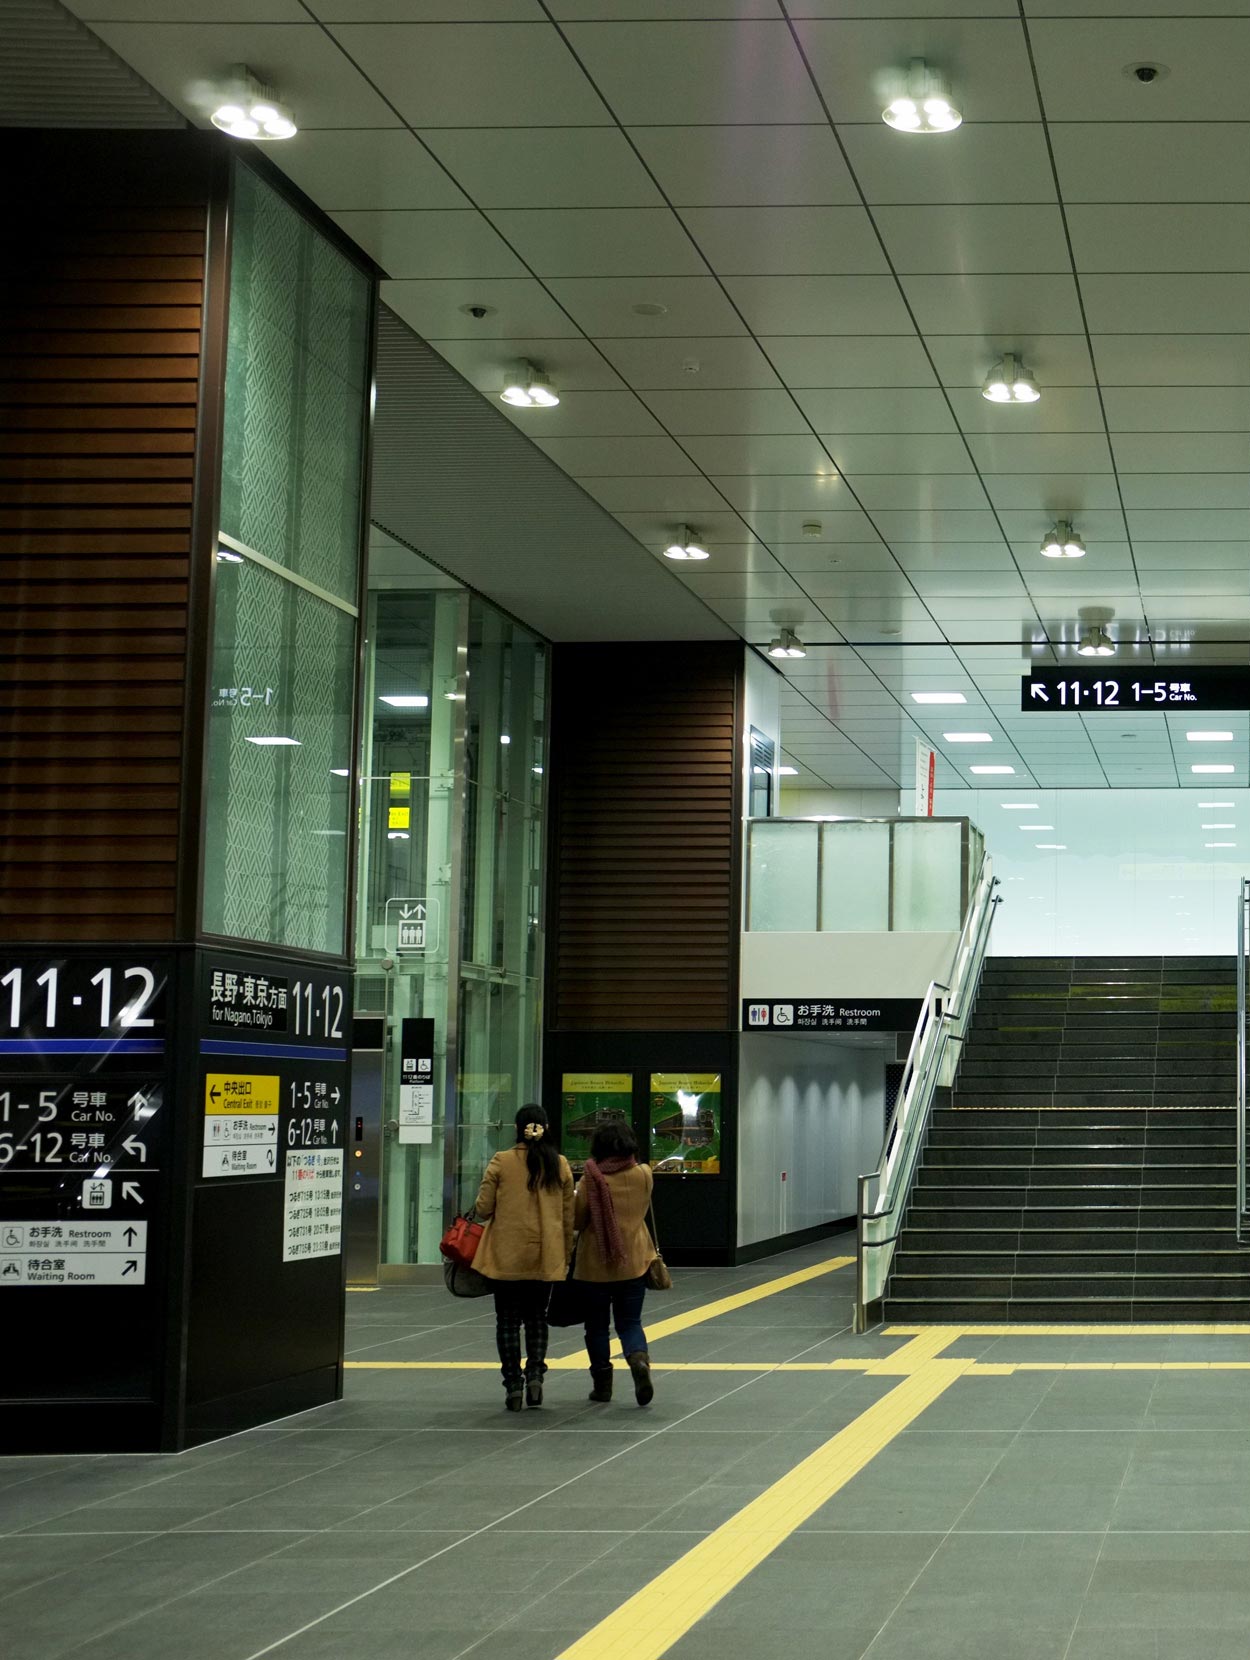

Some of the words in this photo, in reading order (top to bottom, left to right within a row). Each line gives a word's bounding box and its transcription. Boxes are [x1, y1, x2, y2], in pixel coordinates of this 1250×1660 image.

[1169, 693, 1182, 701] Car
[212, 1005, 222, 1021] for
[797, 1005, 835, 1017] お手洗
[839, 1008, 881, 1017] Restroom
[224, 1081, 252, 1096] 中央出口
[72, 1091, 108, 1108] 号車
[223, 1099, 242, 1109] Central
[71, 1110, 92, 1122] Car
[95, 1110, 116, 1122] No.
[70, 1133, 106, 1149] 号車
[69, 1151, 90, 1163] Car
[93, 1151, 114, 1163] No.
[29, 1226, 63, 1238] お手洗
[68, 1229, 112, 1238] Restroom
[28, 1259, 66, 1271] 待合室
[27, 1272, 65, 1282] Waiting
[67, 1272, 96, 1281] Room
